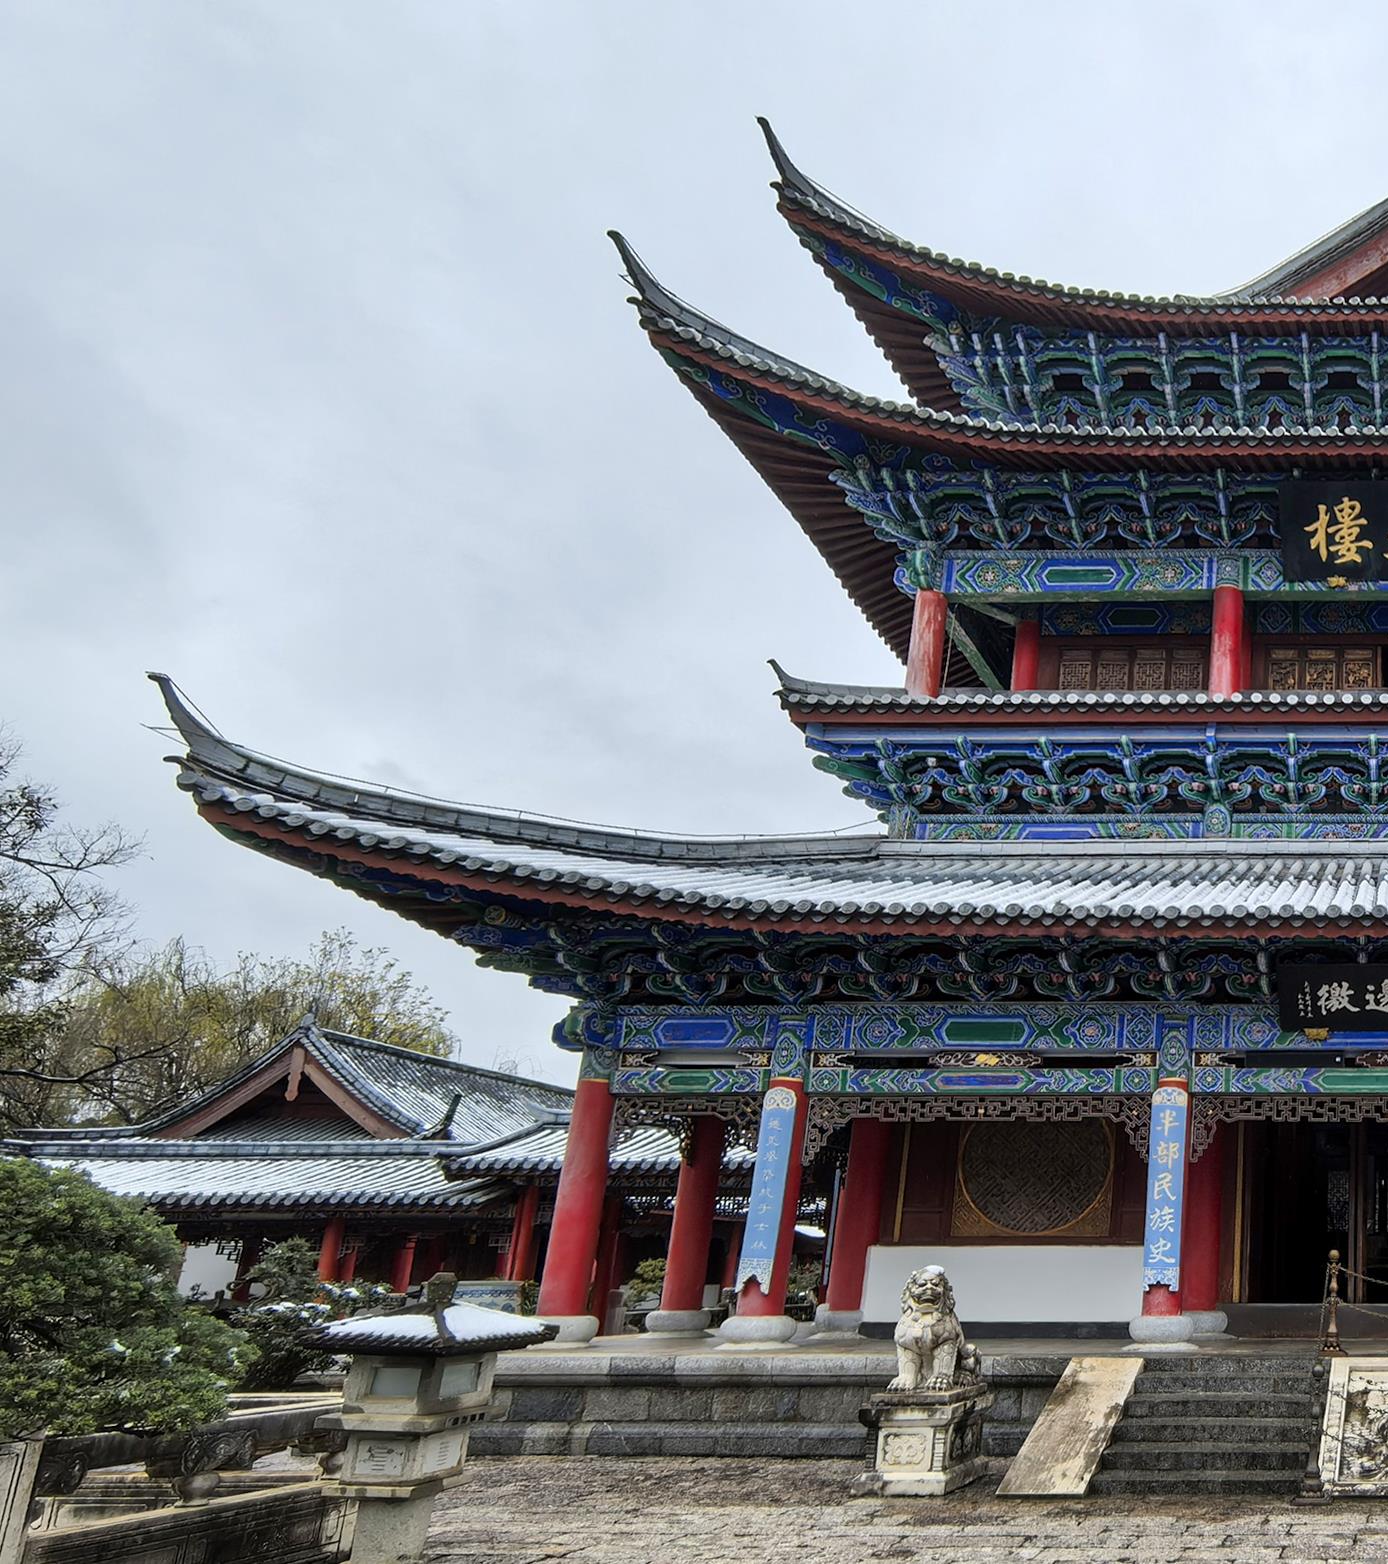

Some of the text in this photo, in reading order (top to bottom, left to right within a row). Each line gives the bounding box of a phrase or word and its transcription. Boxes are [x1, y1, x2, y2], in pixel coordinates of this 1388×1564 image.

[1148, 1109, 1180, 1264] 半部民族史
